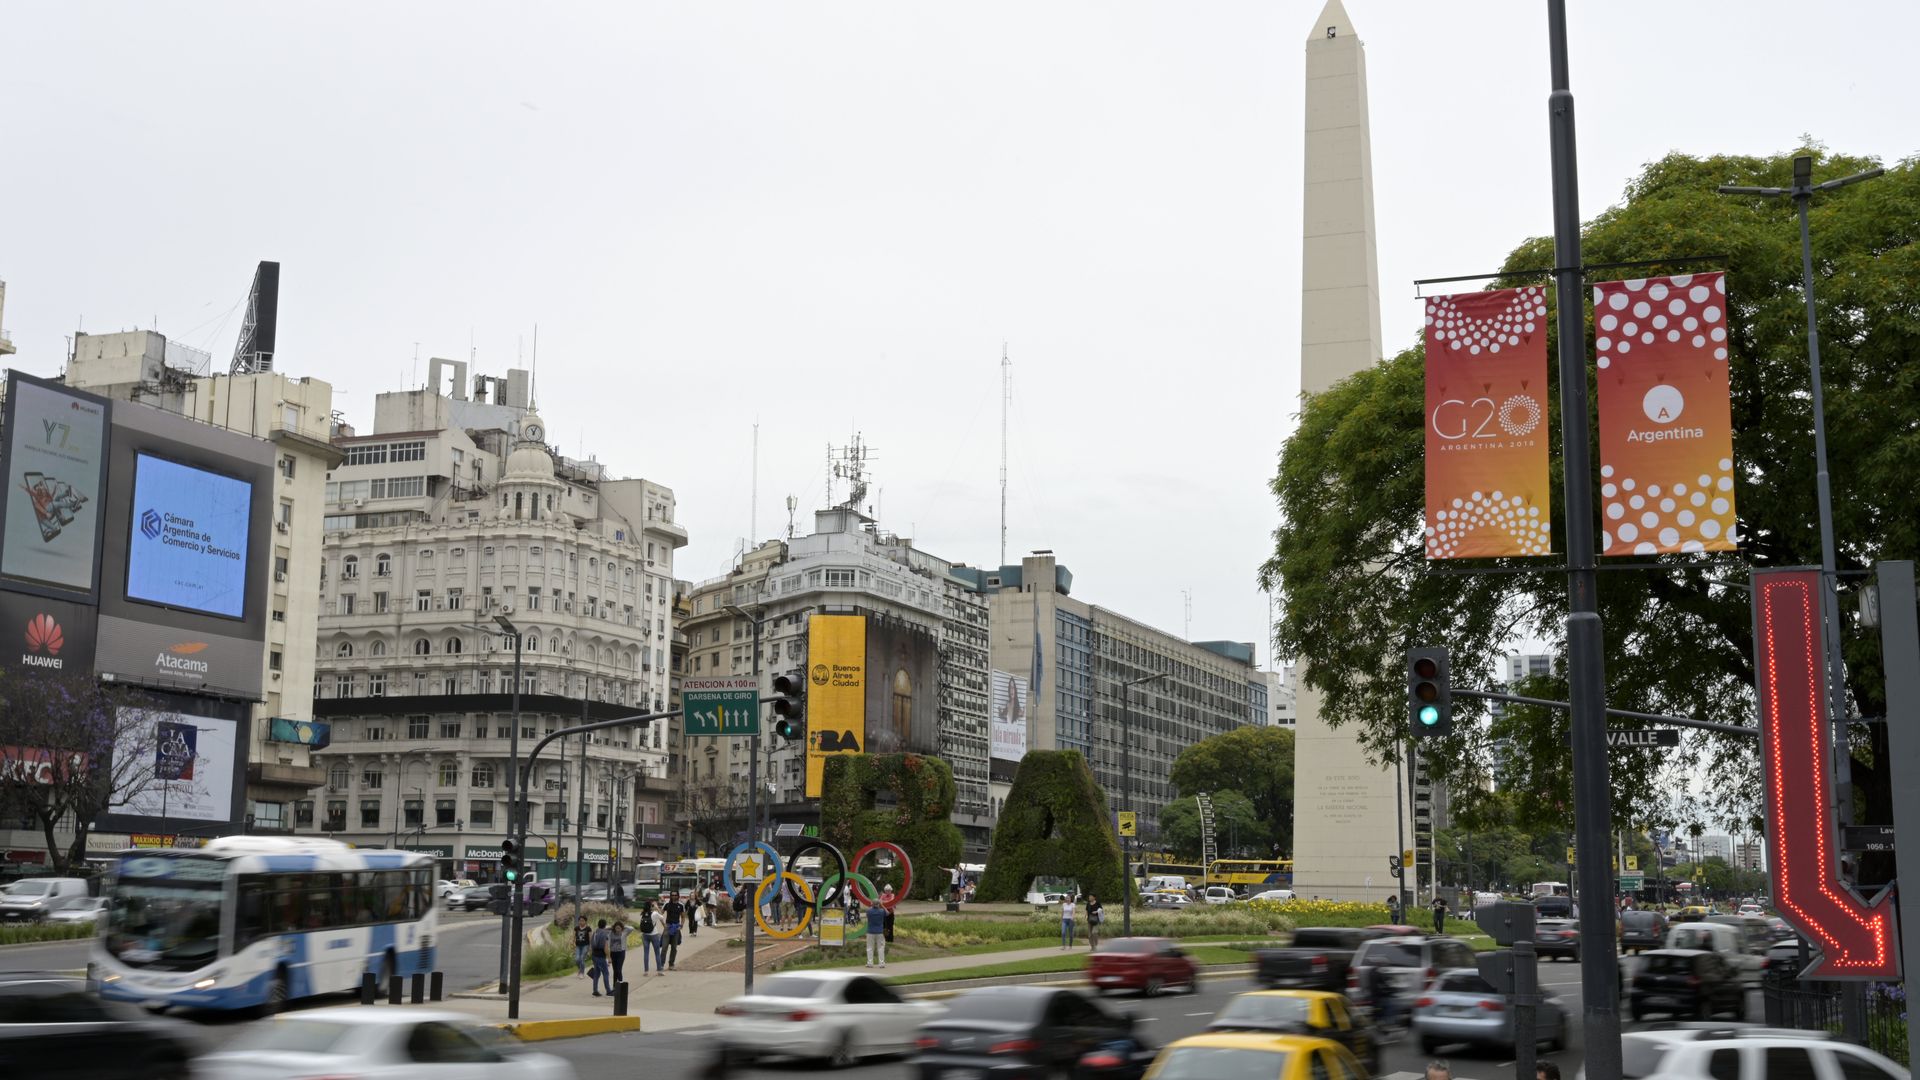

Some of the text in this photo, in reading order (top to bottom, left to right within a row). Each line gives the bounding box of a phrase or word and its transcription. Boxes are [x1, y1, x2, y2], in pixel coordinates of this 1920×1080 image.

[1432, 394, 1541, 440] G20
[1627, 426, 1704, 443] Argentina
[1440, 440, 1535, 451] ARGENTINA 2018
[163, 512, 194, 528] Cámara
[162, 524, 212, 543] Argentina de
[162, 535, 240, 561] Comercio y Servicios
[22, 654, 63, 669] HUAWEI
[155, 652, 208, 673] Atacama
[832, 664, 861, 672] Buenos
[683, 680, 725, 689] ATENCION
[735, 680, 748, 688] 100
[722, 692, 733, 700] DE
[734, 692, 752, 700] GIRO
[1606, 731, 1658, 746] VALLE
[87, 838, 123, 850] Souvenirs
[133, 836, 173, 845] MAXIKIOCO
[1866, 843, 1884, 851] 1050
[467, 849, 506, 858] McDonal
